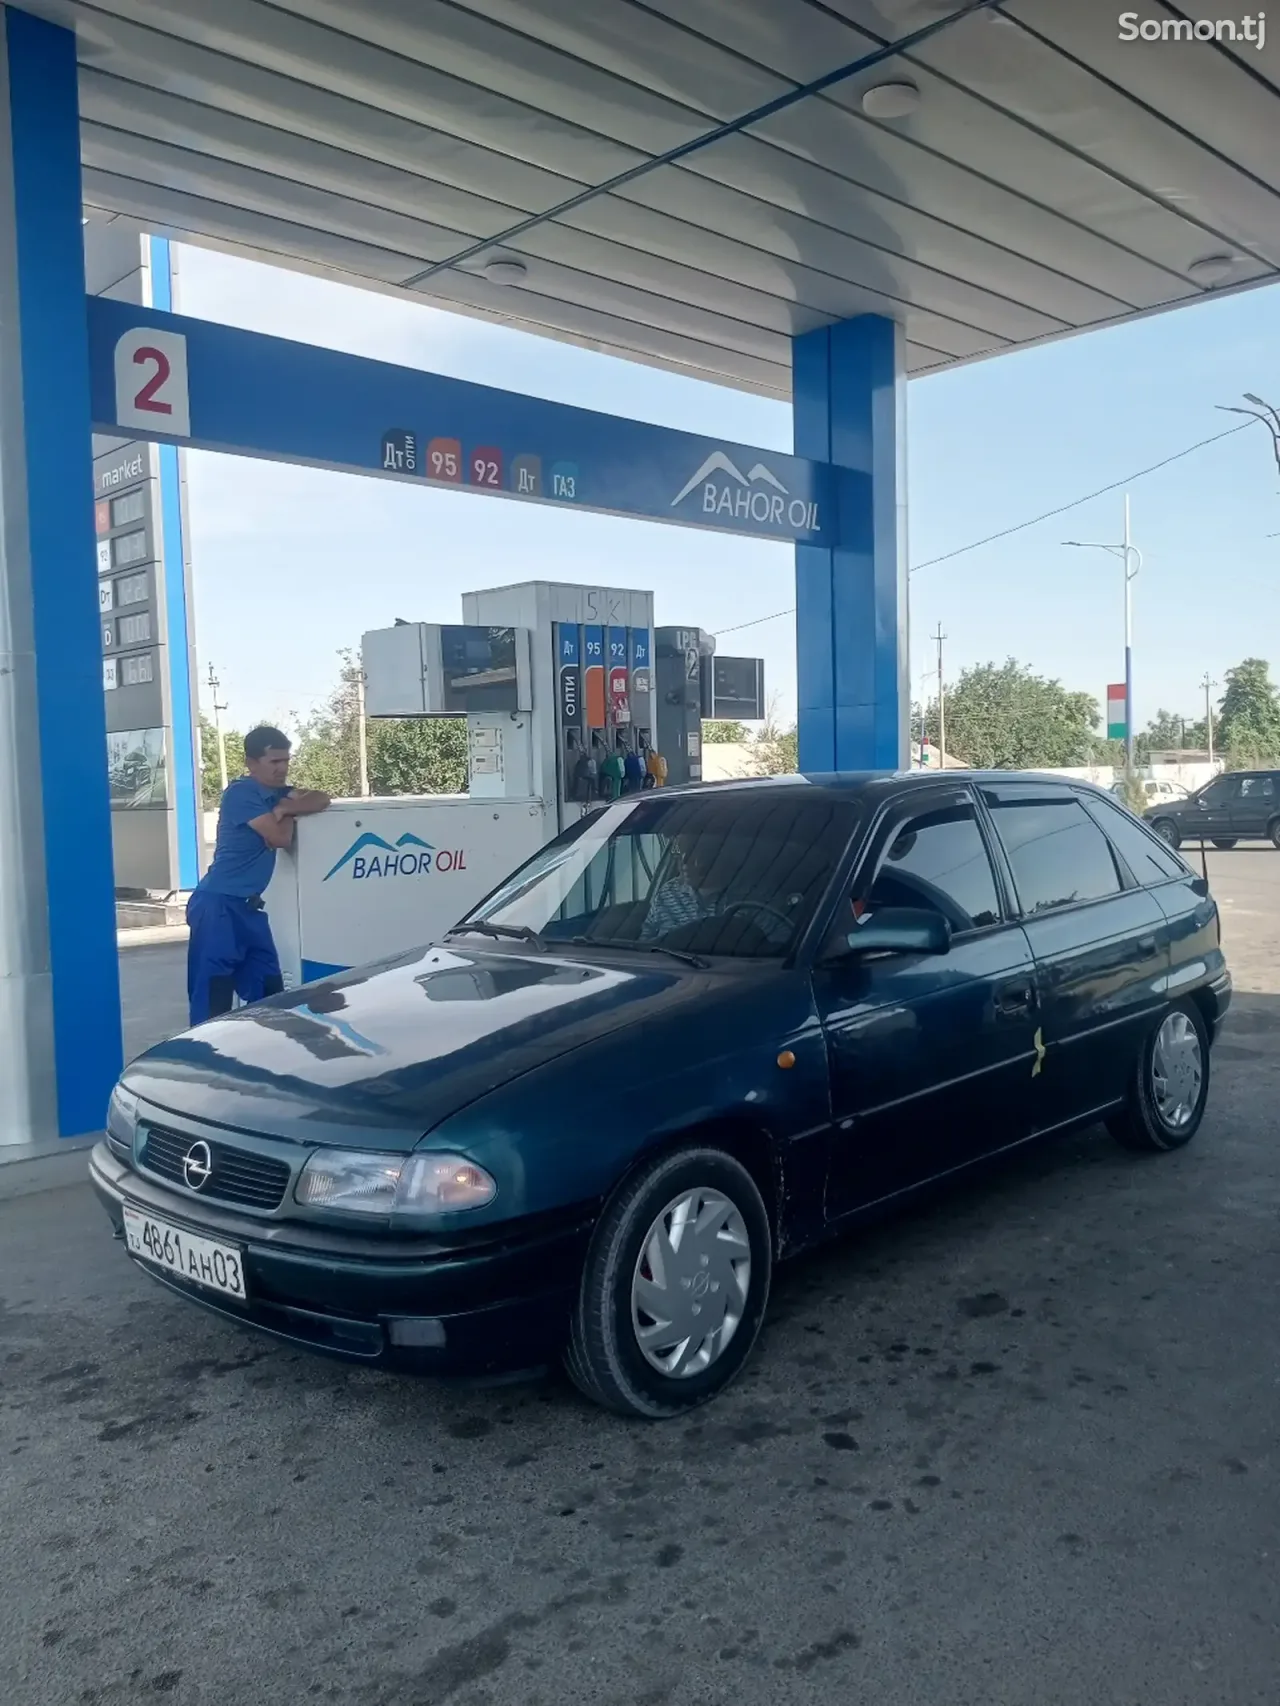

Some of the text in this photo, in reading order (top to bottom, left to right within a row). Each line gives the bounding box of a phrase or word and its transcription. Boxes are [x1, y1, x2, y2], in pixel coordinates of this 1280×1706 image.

[133, 346, 172, 415] 2
[102, 453, 143, 488] market
[431, 451, 457, 476] 95
[474, 459, 499, 485] 92
[553, 475, 575, 498] ГАЗ
[702, 483, 821, 531] BAHOR OIL
[587, 642, 600, 655] 95
[611, 643, 625, 656] 92
[353, 850, 466, 879] BAHOR OIL
